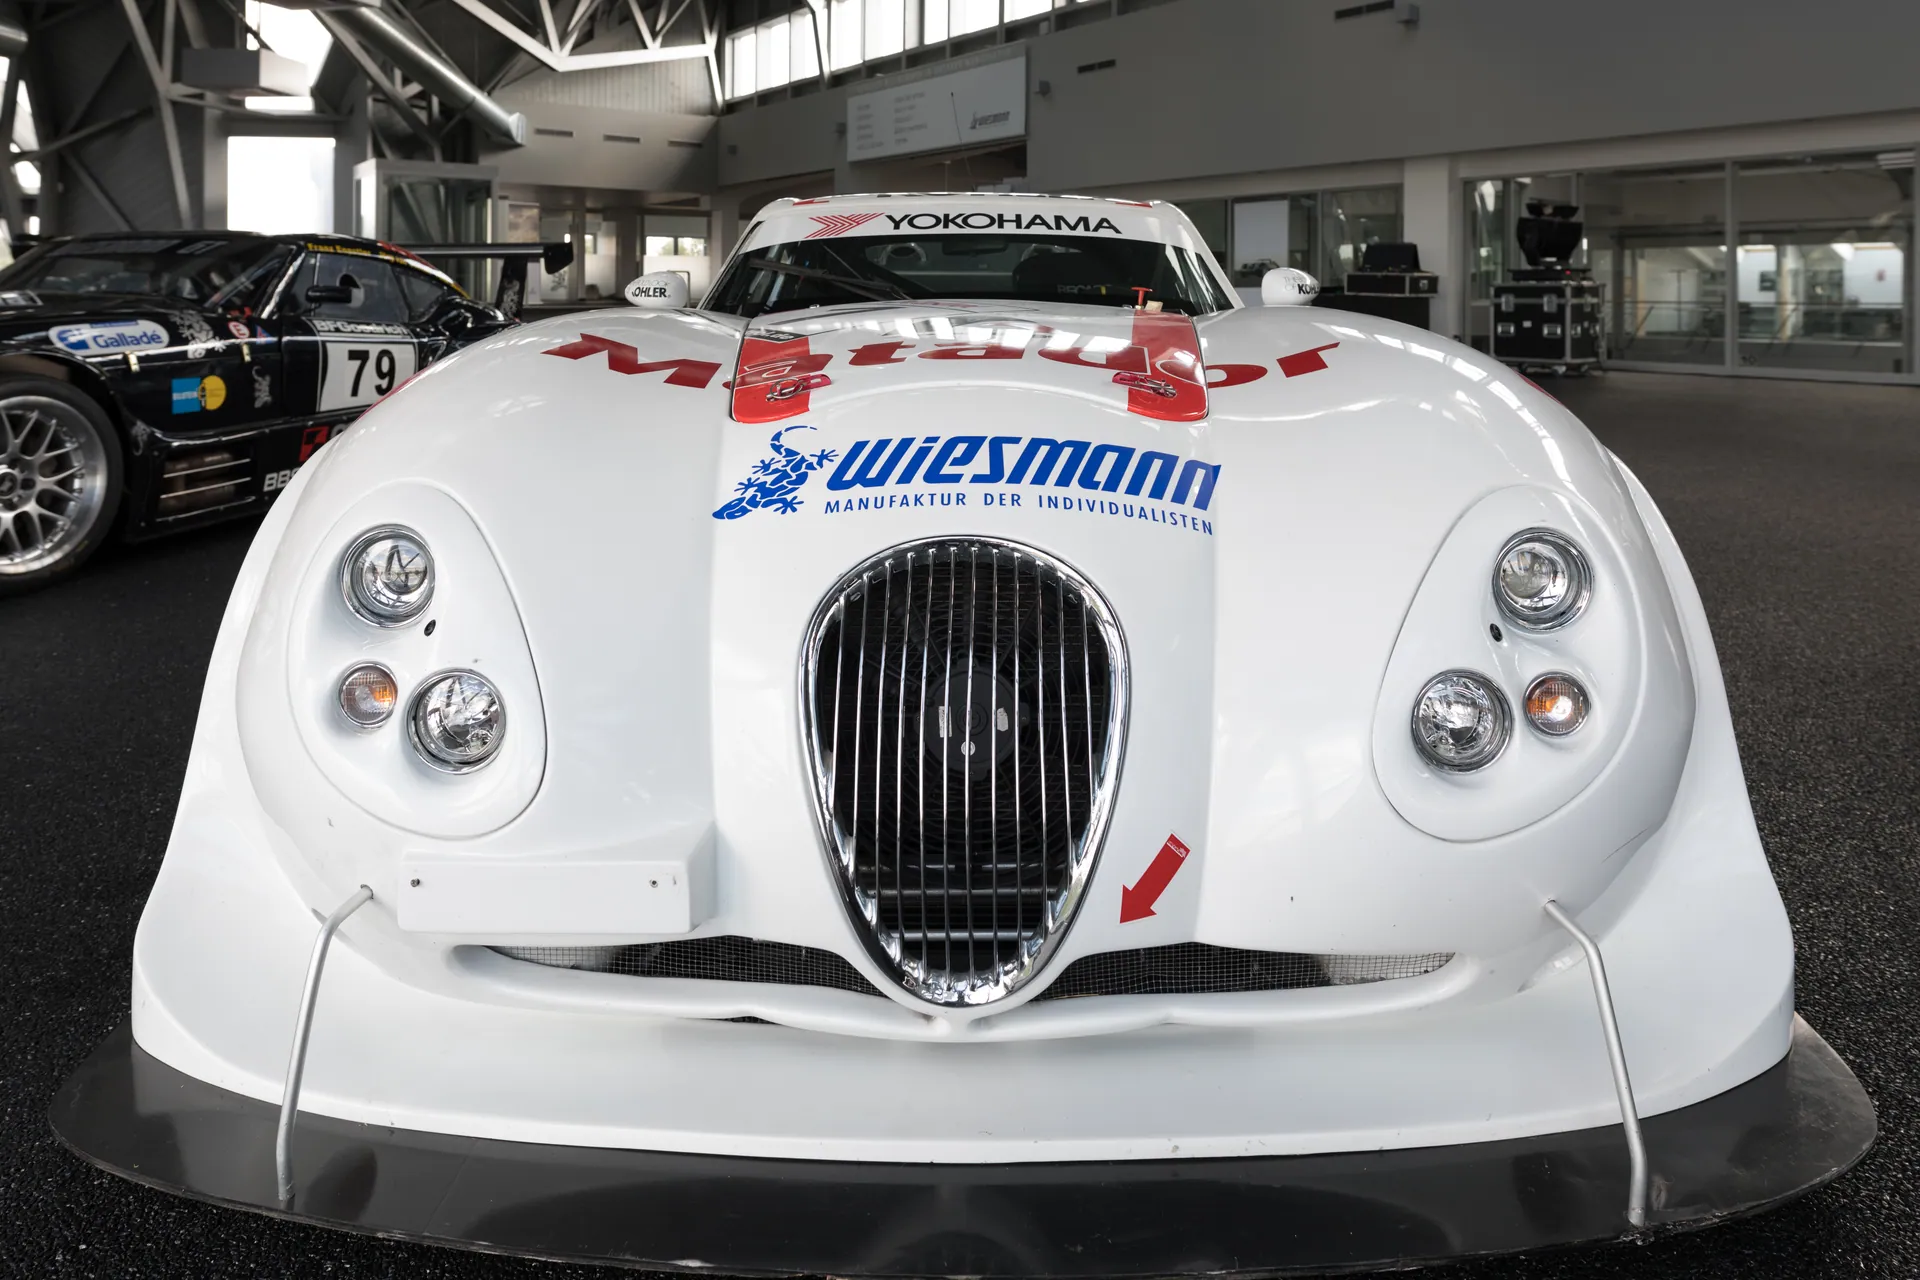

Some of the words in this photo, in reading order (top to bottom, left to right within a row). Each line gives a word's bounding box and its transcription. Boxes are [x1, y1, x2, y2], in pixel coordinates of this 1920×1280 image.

[884, 212, 1123, 235] YOKOHAMA
[631, 286, 667, 298] OHLER
[1297, 283, 1320, 295] KOHL
[312, 320, 409, 335] BFGoodrich
[93, 329, 163, 349] Galladé
[347, 348, 396, 397] 79
[540, 333, 1341, 391] Matador
[825, 493, 967, 514] MANUFAKTUR
[983, 493, 1021, 507] DER
[1038, 495, 1213, 535] INDIVIDUALISTEN
